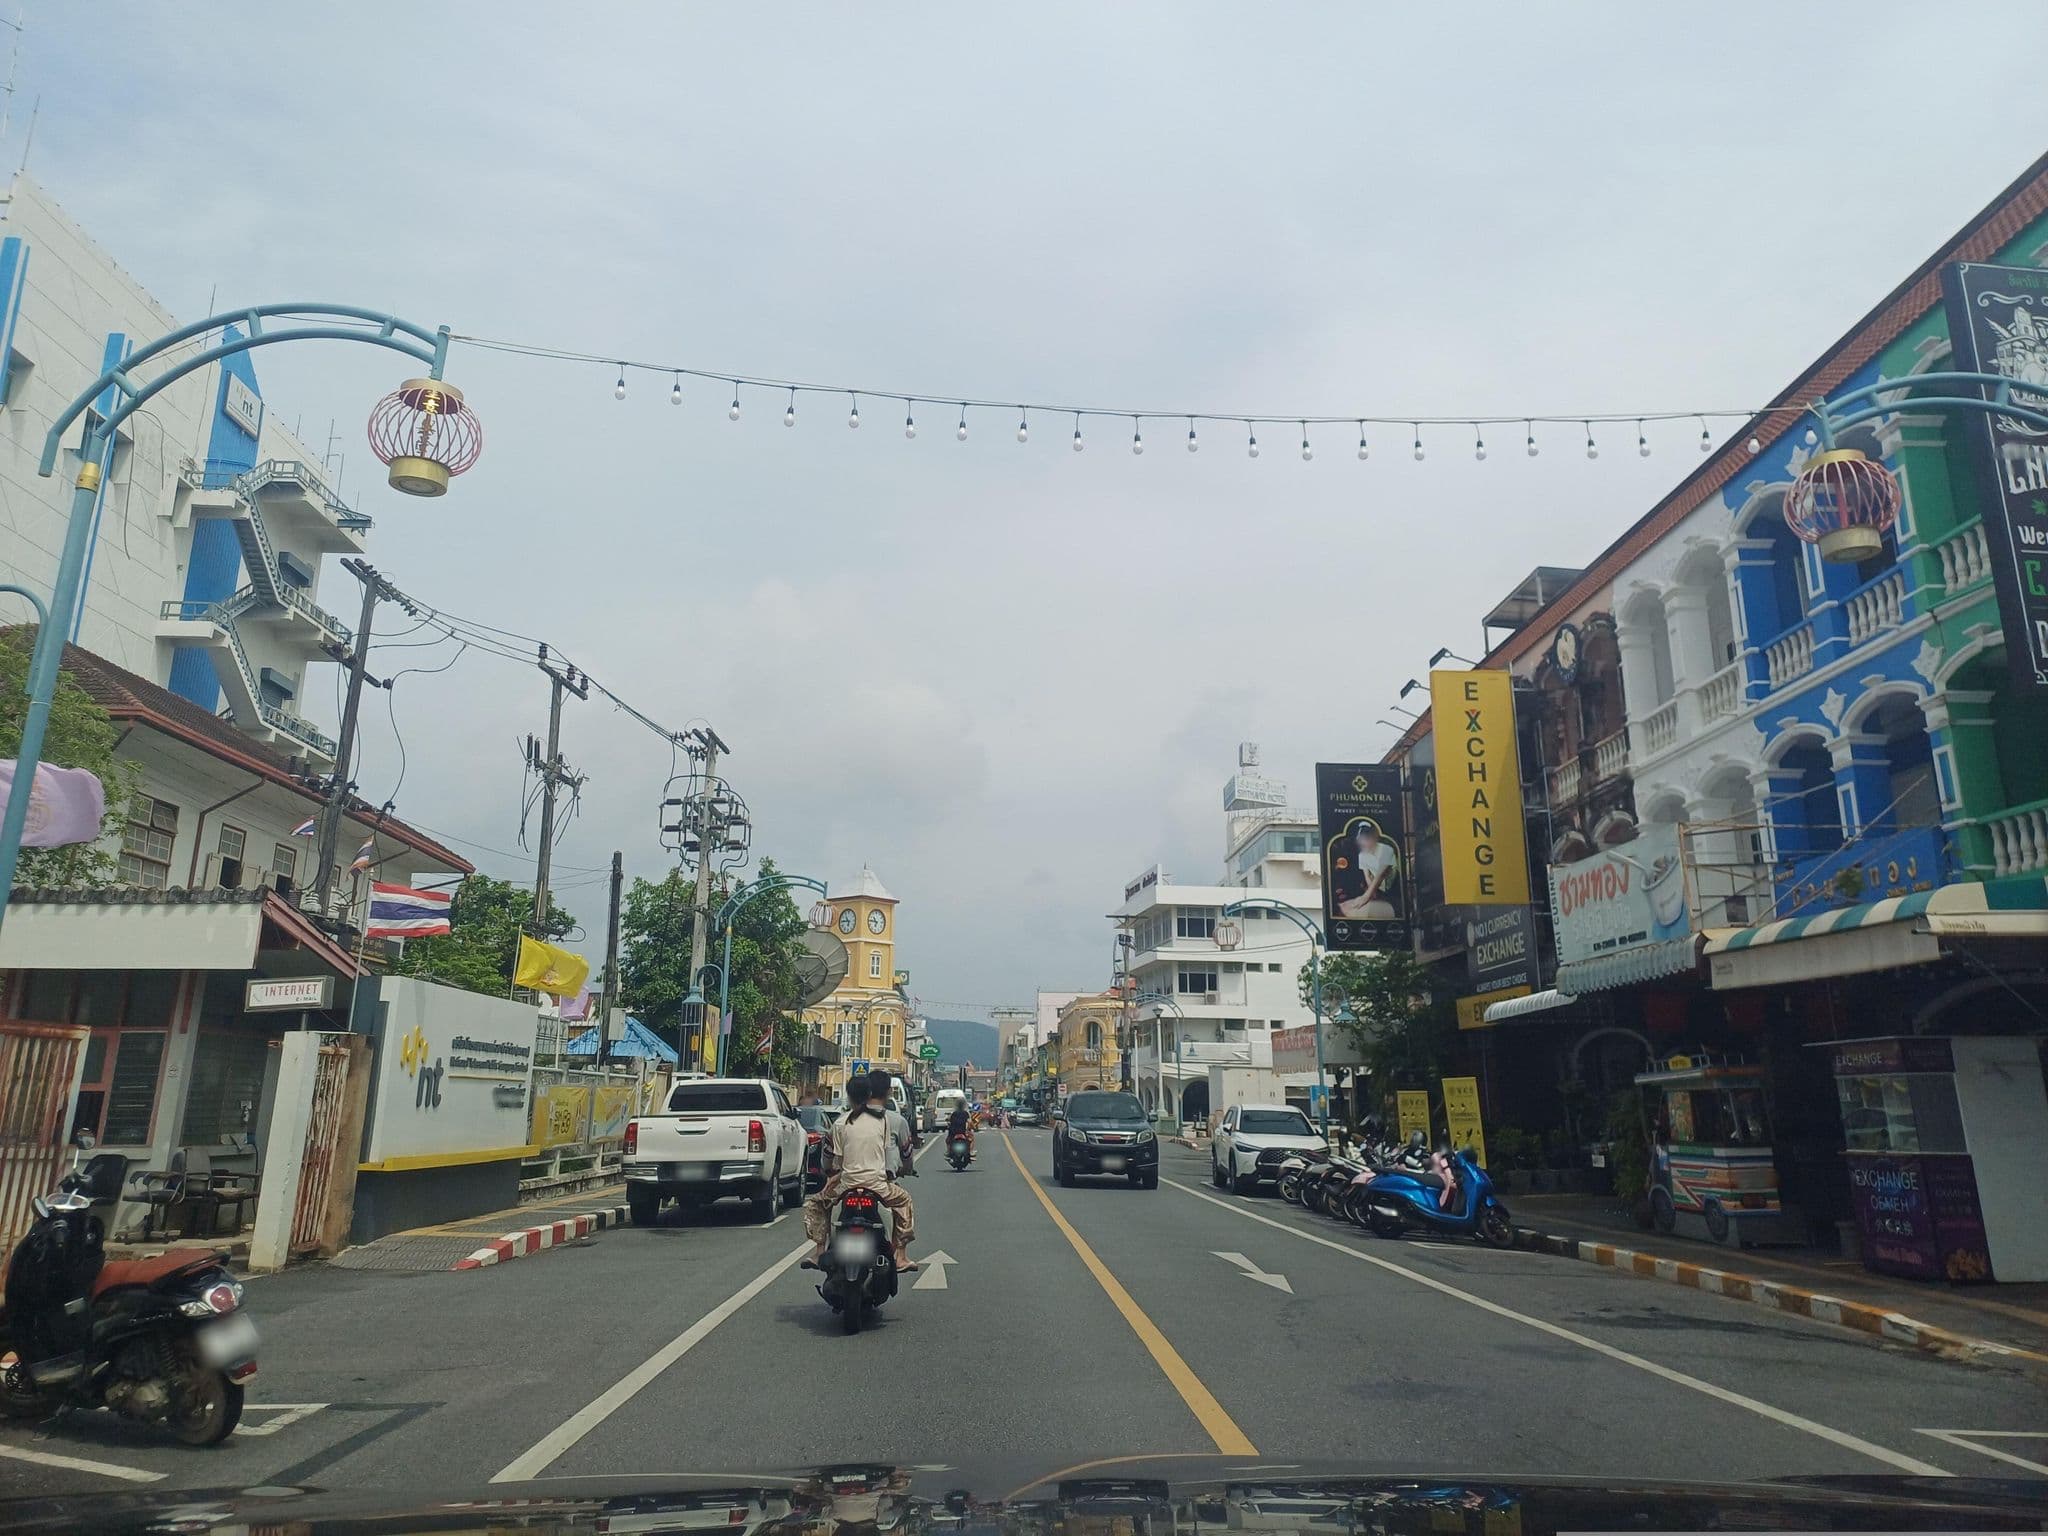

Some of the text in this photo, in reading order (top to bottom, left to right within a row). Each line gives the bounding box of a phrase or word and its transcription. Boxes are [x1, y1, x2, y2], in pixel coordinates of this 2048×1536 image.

[242, 399, 254, 418] nt
[1329, 792, 1393, 804] PHUMONTRA
[1463, 680, 1496, 898] EXCHANGE
[1559, 863, 1630, 918] ชามทอง
[1488, 910, 1521, 933] CURRENCY
[1477, 932, 1525, 965] EXCHANGE
[264, 983, 318, 997] INTERNET
[1835, 1052, 1882, 1066] EXCHANGE
[415, 1057, 444, 1109] nt
[1855, 1168, 1919, 1191] EXCHANGE
